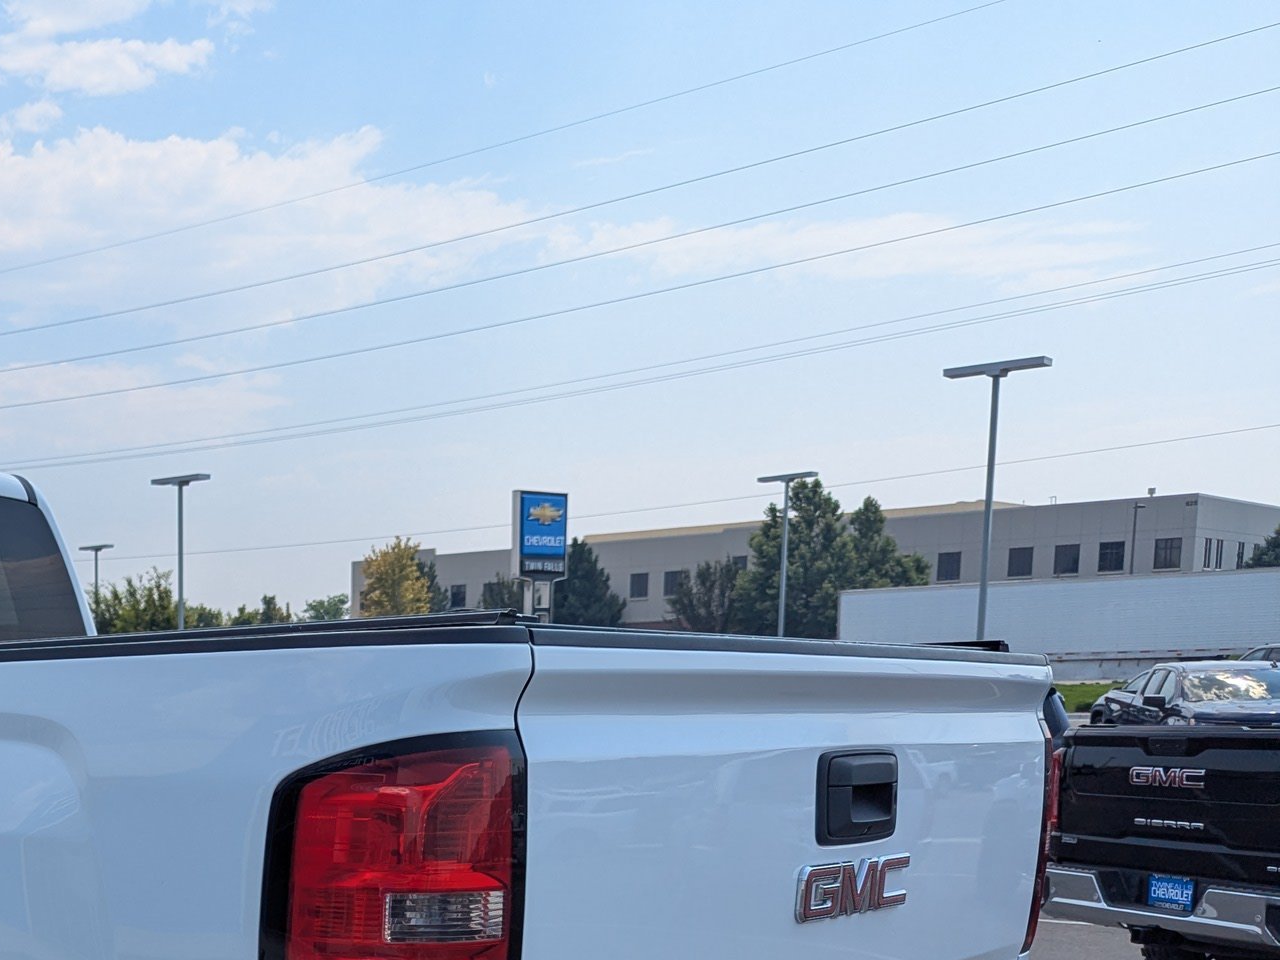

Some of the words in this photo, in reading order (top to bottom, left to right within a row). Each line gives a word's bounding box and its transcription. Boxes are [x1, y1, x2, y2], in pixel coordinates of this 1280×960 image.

[524, 535, 565, 547] CHEVROLET
[525, 561, 543, 571] TWIN
[544, 561, 564, 572] FALLS
[1129, 766, 1206, 788] GMC
[1133, 817, 1205, 830] SIERRA
[794, 852, 911, 924] GMC
[1151, 881, 1193, 892] TWINFALLS
[1151, 887, 1193, 901] CHEVROLET
